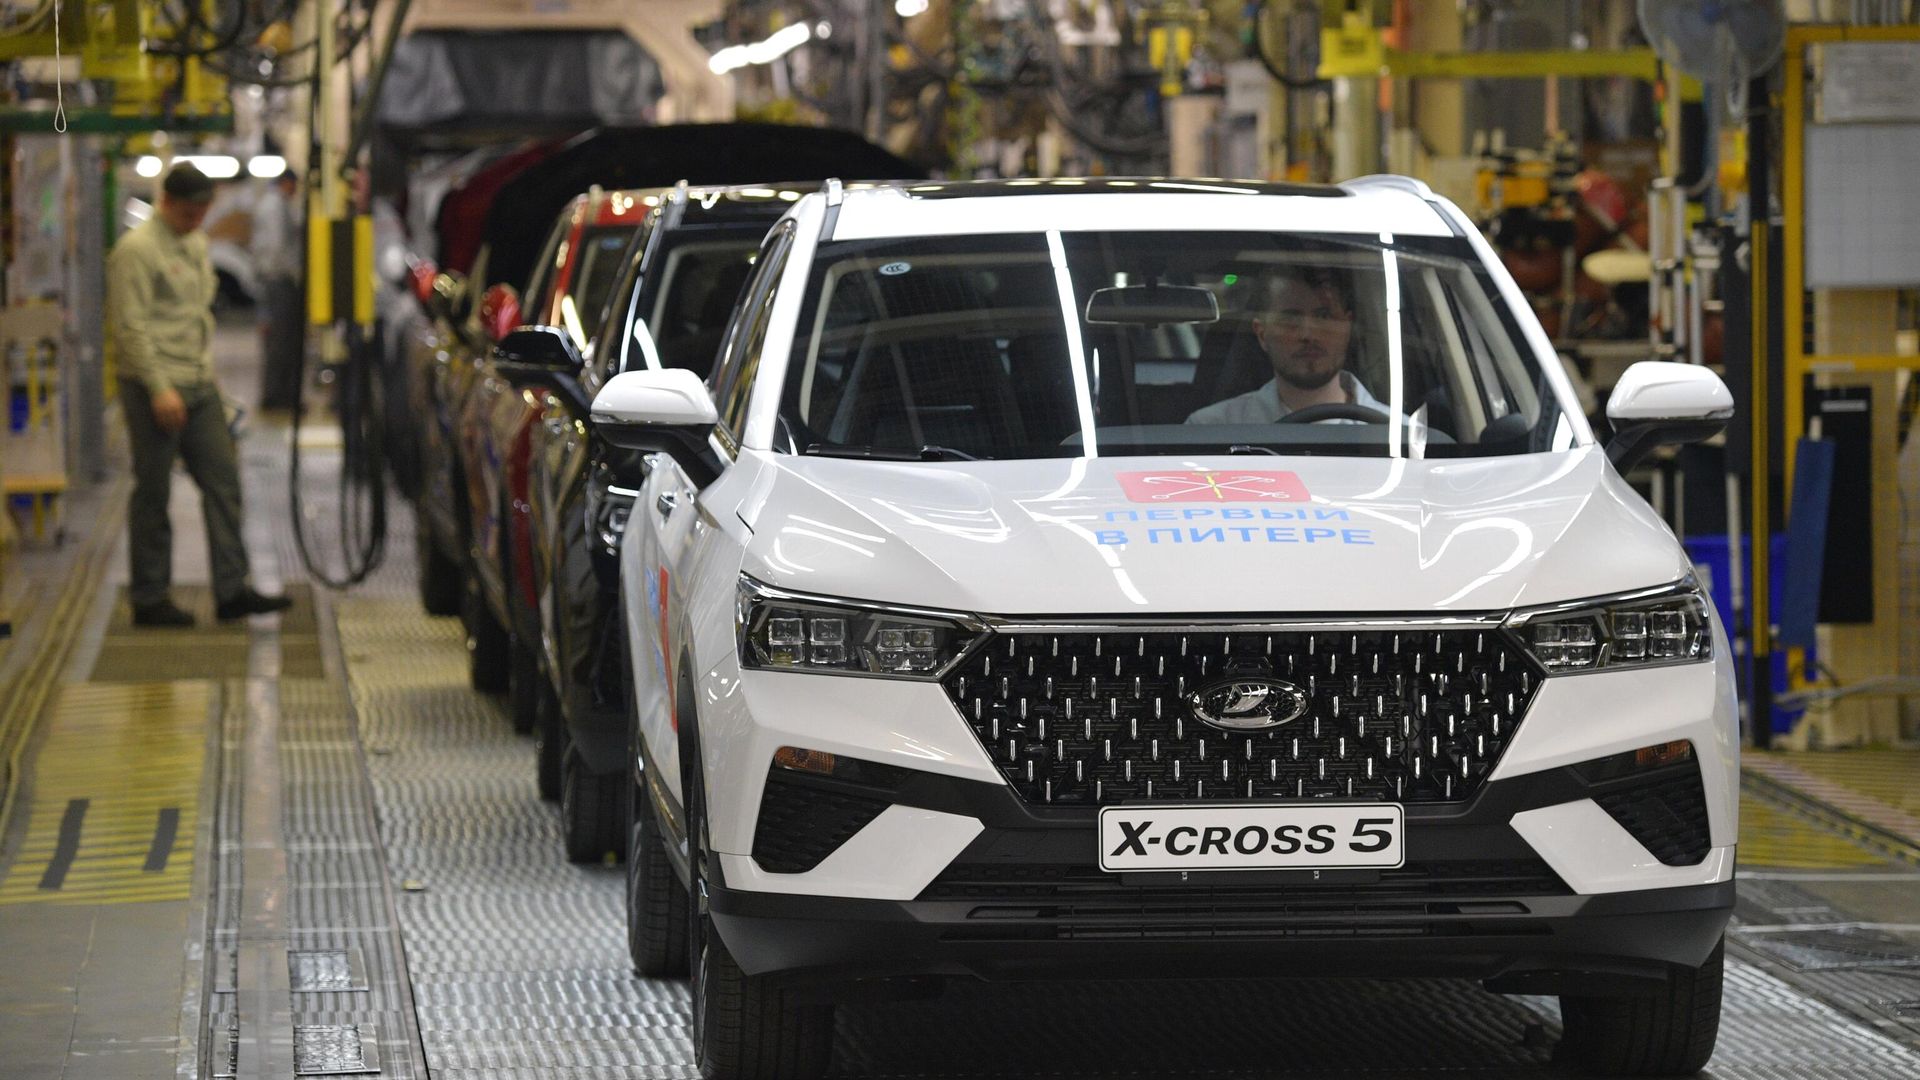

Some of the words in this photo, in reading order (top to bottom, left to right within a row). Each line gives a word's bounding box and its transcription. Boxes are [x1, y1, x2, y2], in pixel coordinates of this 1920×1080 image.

[1095, 530, 1129, 546] В
[1147, 527, 1376, 545] ПИТЕРЕ
[1110, 820, 1336, 856] X-CROSS
[1349, 818, 1394, 853] 5
